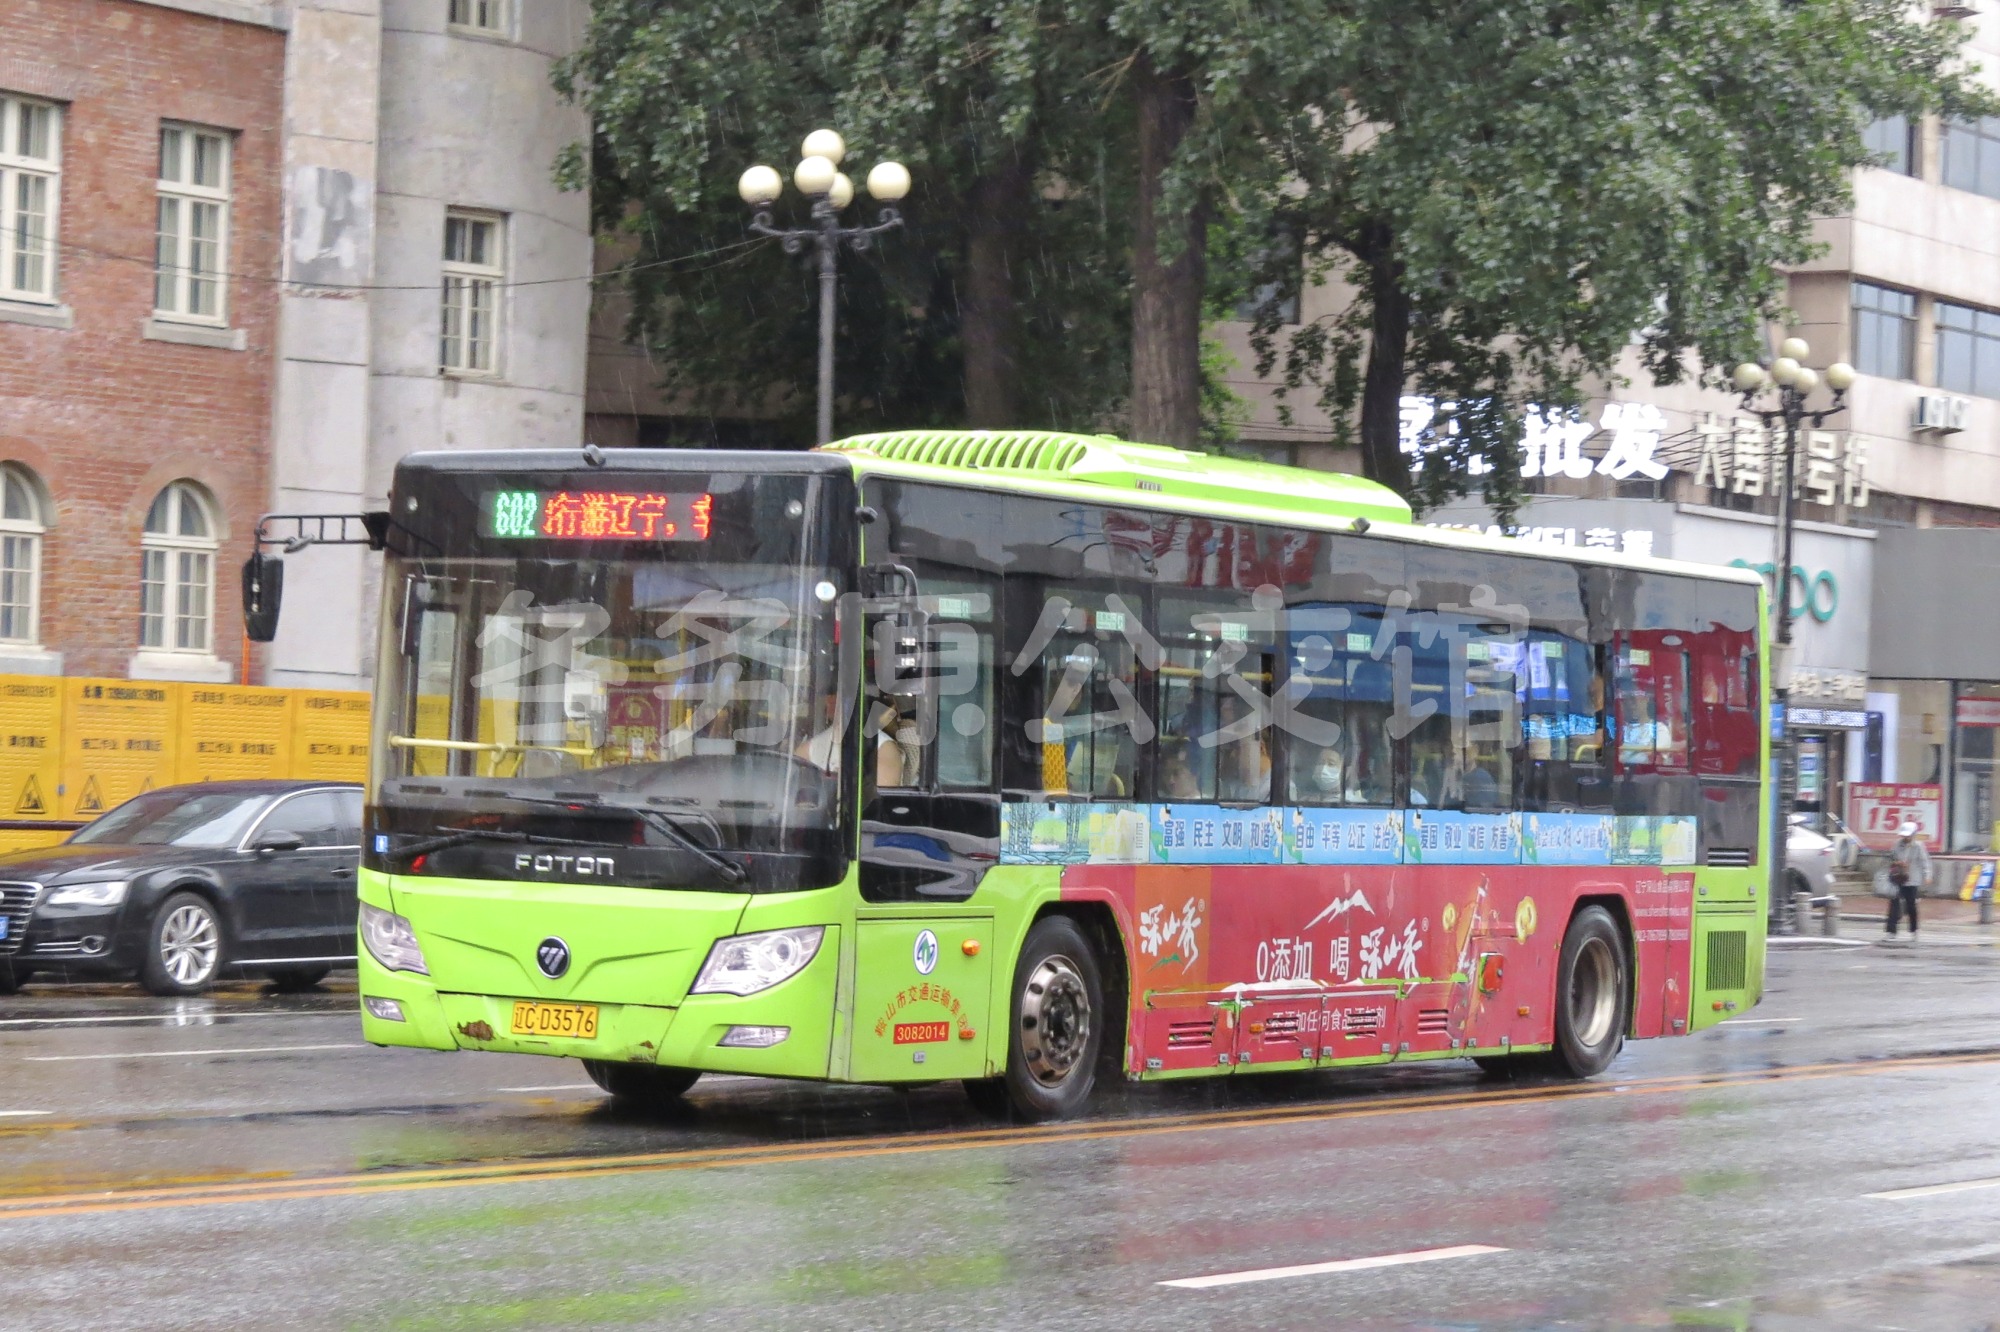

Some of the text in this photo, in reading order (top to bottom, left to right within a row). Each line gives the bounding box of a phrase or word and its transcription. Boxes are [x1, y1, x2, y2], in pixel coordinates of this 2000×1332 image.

[496, 492, 538, 536] 602
[1163, 820, 1185, 848] 富强
[1193, 820, 1215, 848] 民主
[1222, 820, 1243, 848] 文明
[1249, 821, 1271, 848] 和谐
[1296, 823, 1391, 850] 自由 平等 公正 法治
[1420, 824, 1508, 850] 爱国 敬业 诚信 友善
[514, 853, 615, 876] FOTON
[1256, 936, 1312, 981] 0添加
[1330, 936, 1350, 981] 喝
[897, 1024, 947, 1041] 3082014
